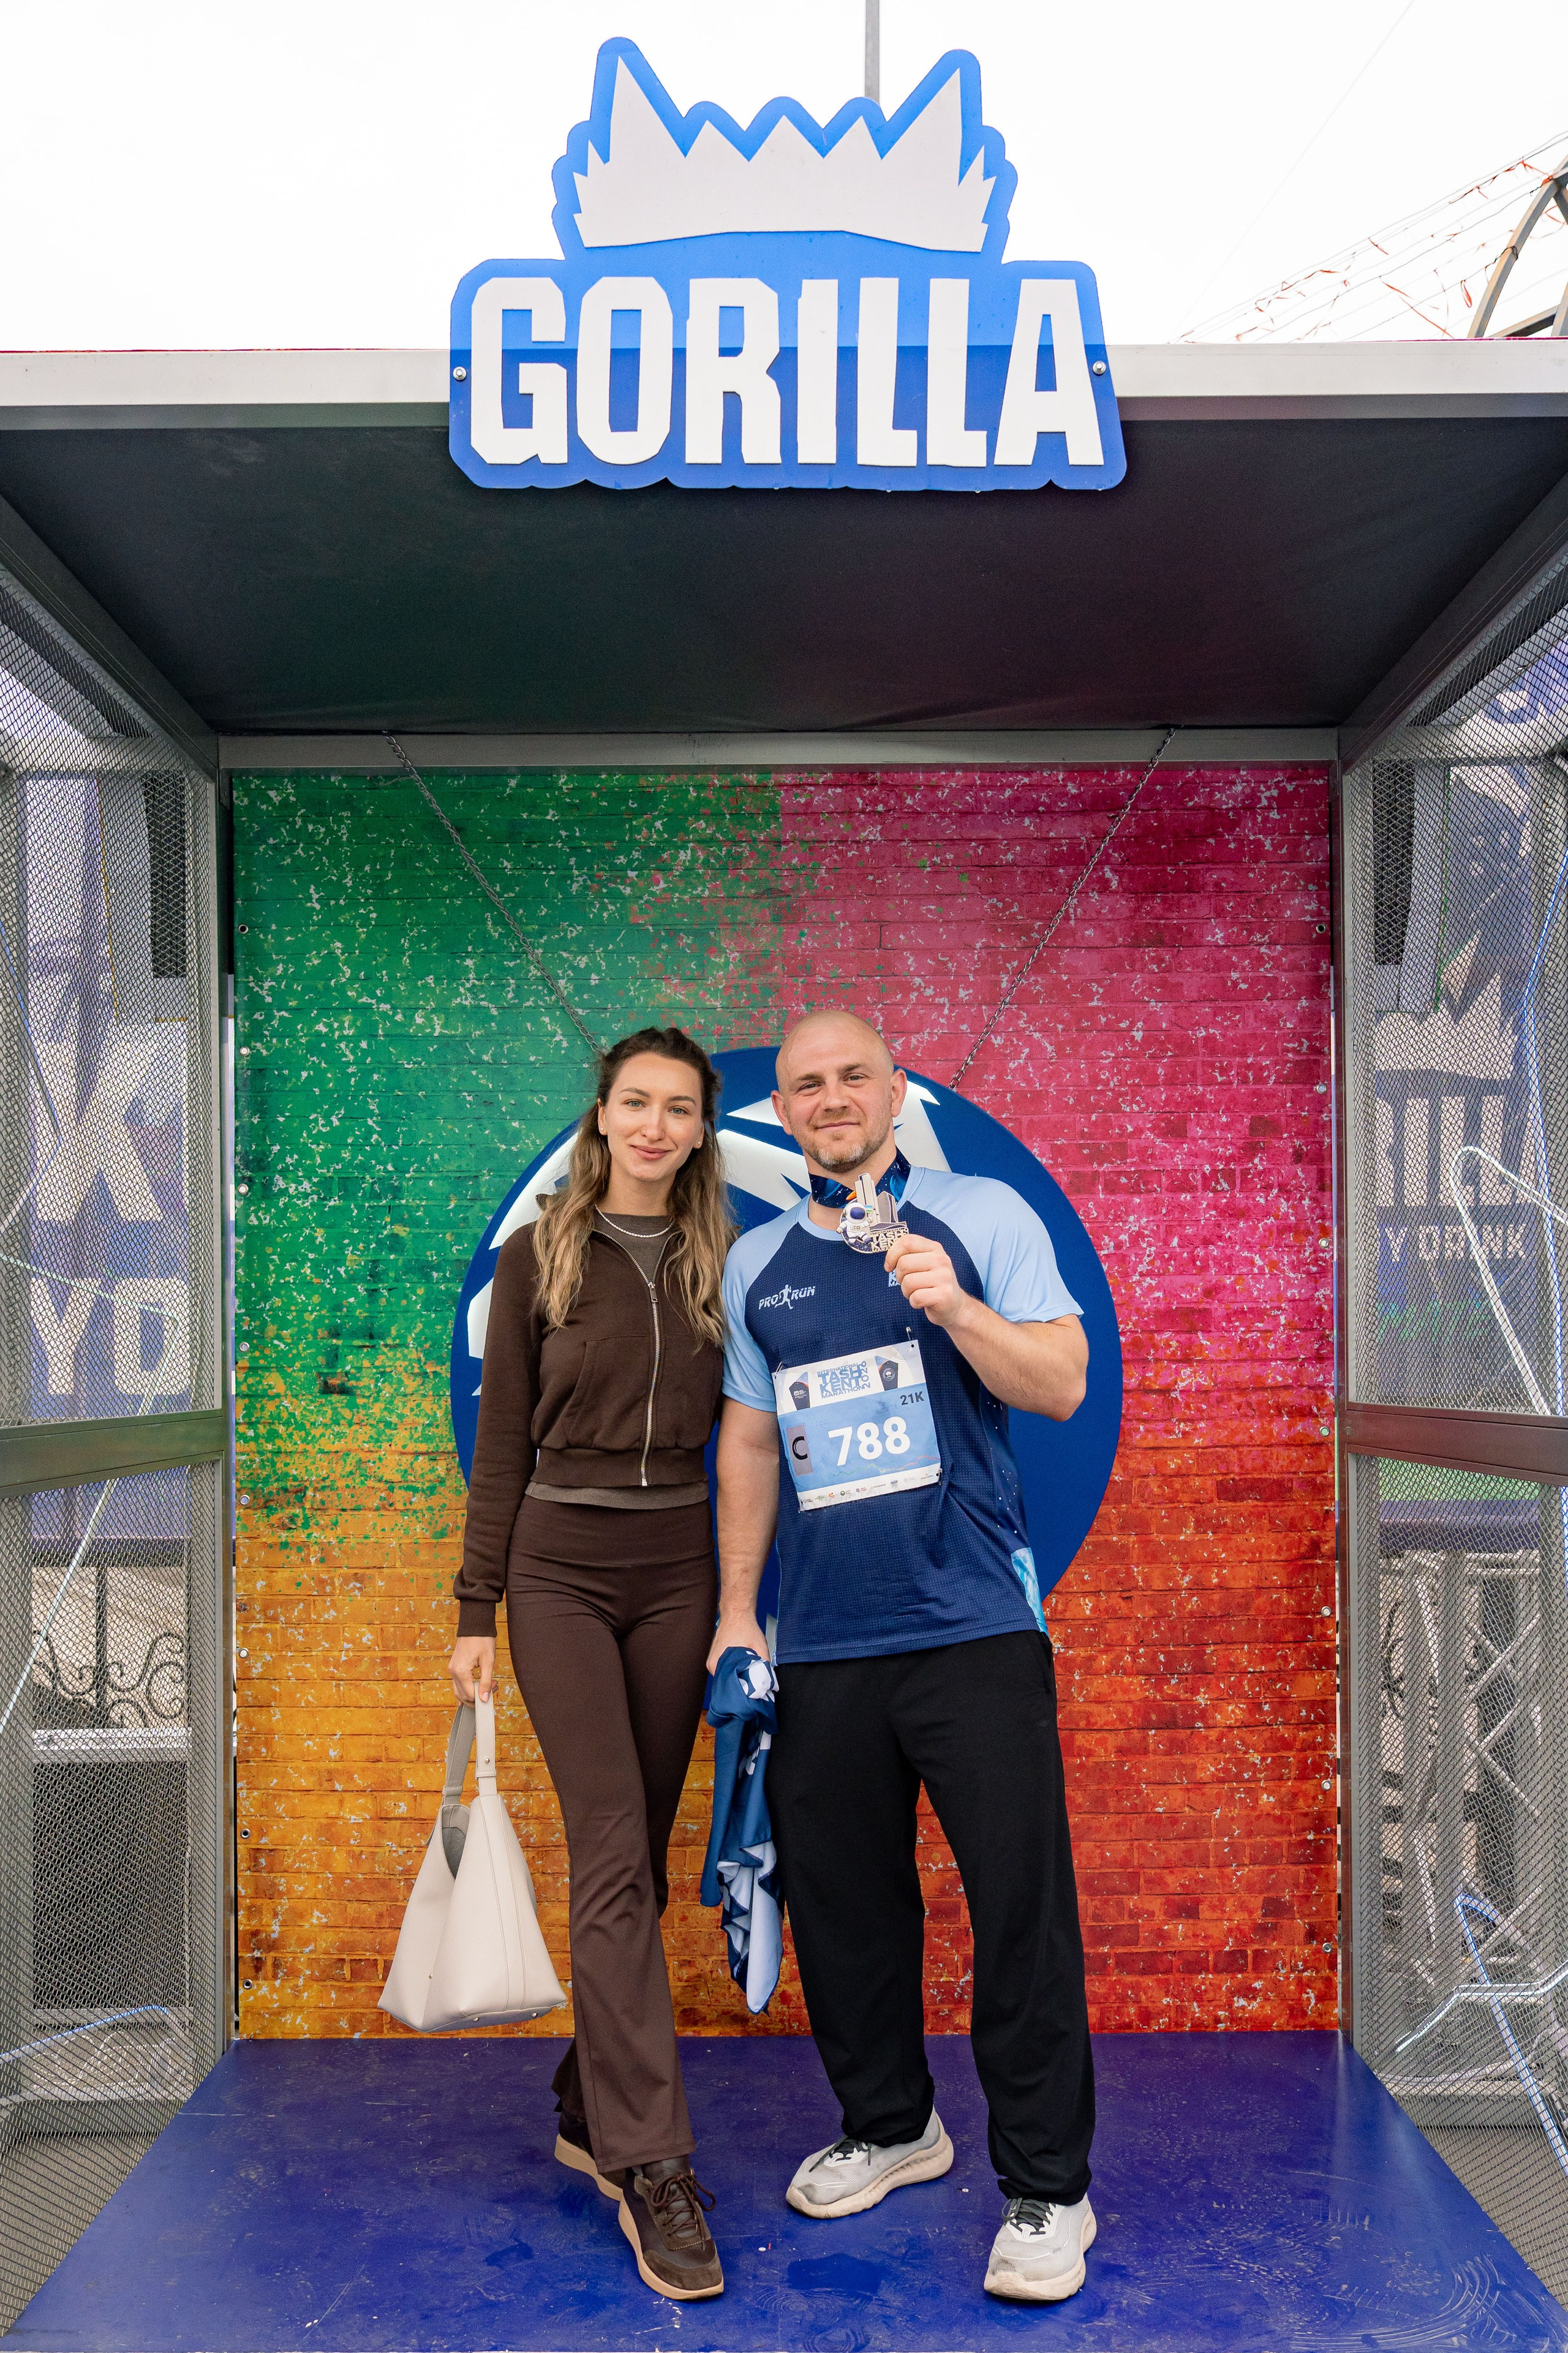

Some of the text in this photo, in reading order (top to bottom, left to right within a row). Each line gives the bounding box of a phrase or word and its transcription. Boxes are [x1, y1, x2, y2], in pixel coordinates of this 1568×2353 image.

[470, 276, 1104, 467] GORILLA
[871, 1237, 896, 1250] KEN
[1418, 1224, 1527, 1260] DRNK
[758, 1286, 816, 1310] PRO RUN
[817, 1362, 858, 1375] INTERNATIONAL
[818, 1364, 862, 1384] TASH
[820, 1376, 861, 1396] KENT
[821, 1385, 864, 1399] MARATHON
[900, 1391, 924, 1406] 21K
[792, 1436, 808, 1460] C
[828, 1416, 910, 1466] 788
